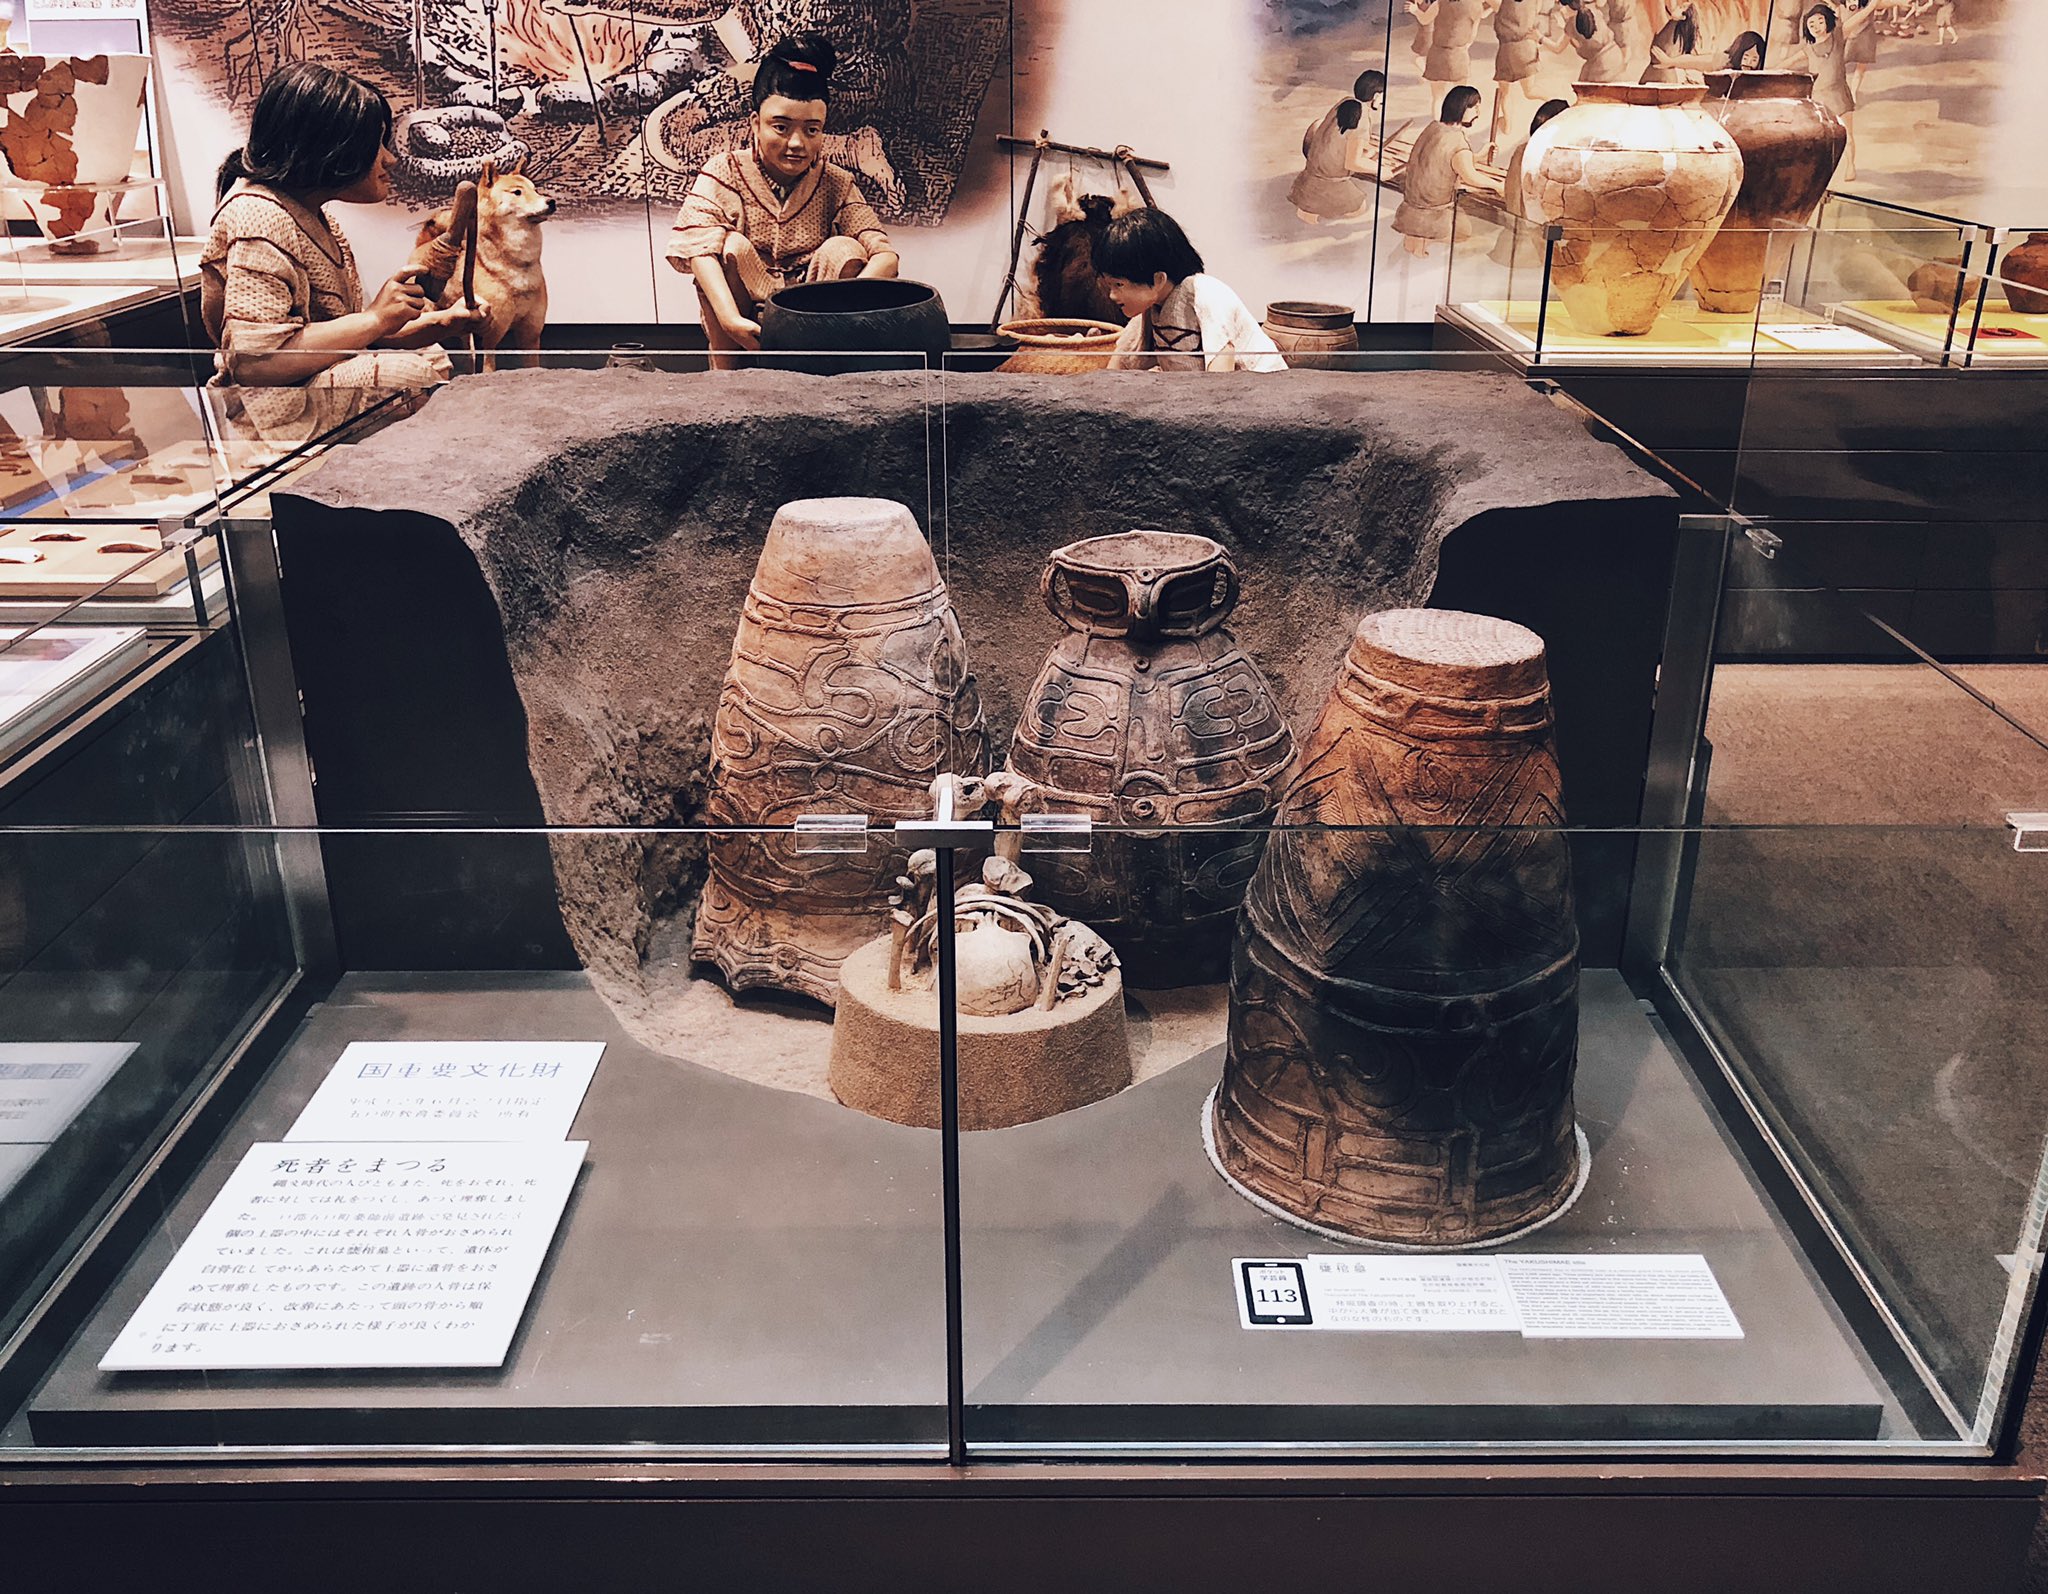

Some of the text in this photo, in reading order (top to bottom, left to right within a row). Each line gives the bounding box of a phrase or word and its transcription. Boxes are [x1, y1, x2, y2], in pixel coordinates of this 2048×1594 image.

[357, 1062, 563, 1079] 国重要文化財
[270, 1157, 447, 1175] 死者をまつる
[1256, 1288, 1299, 1303] 113
[151, 1343, 202, 1353] ります。
